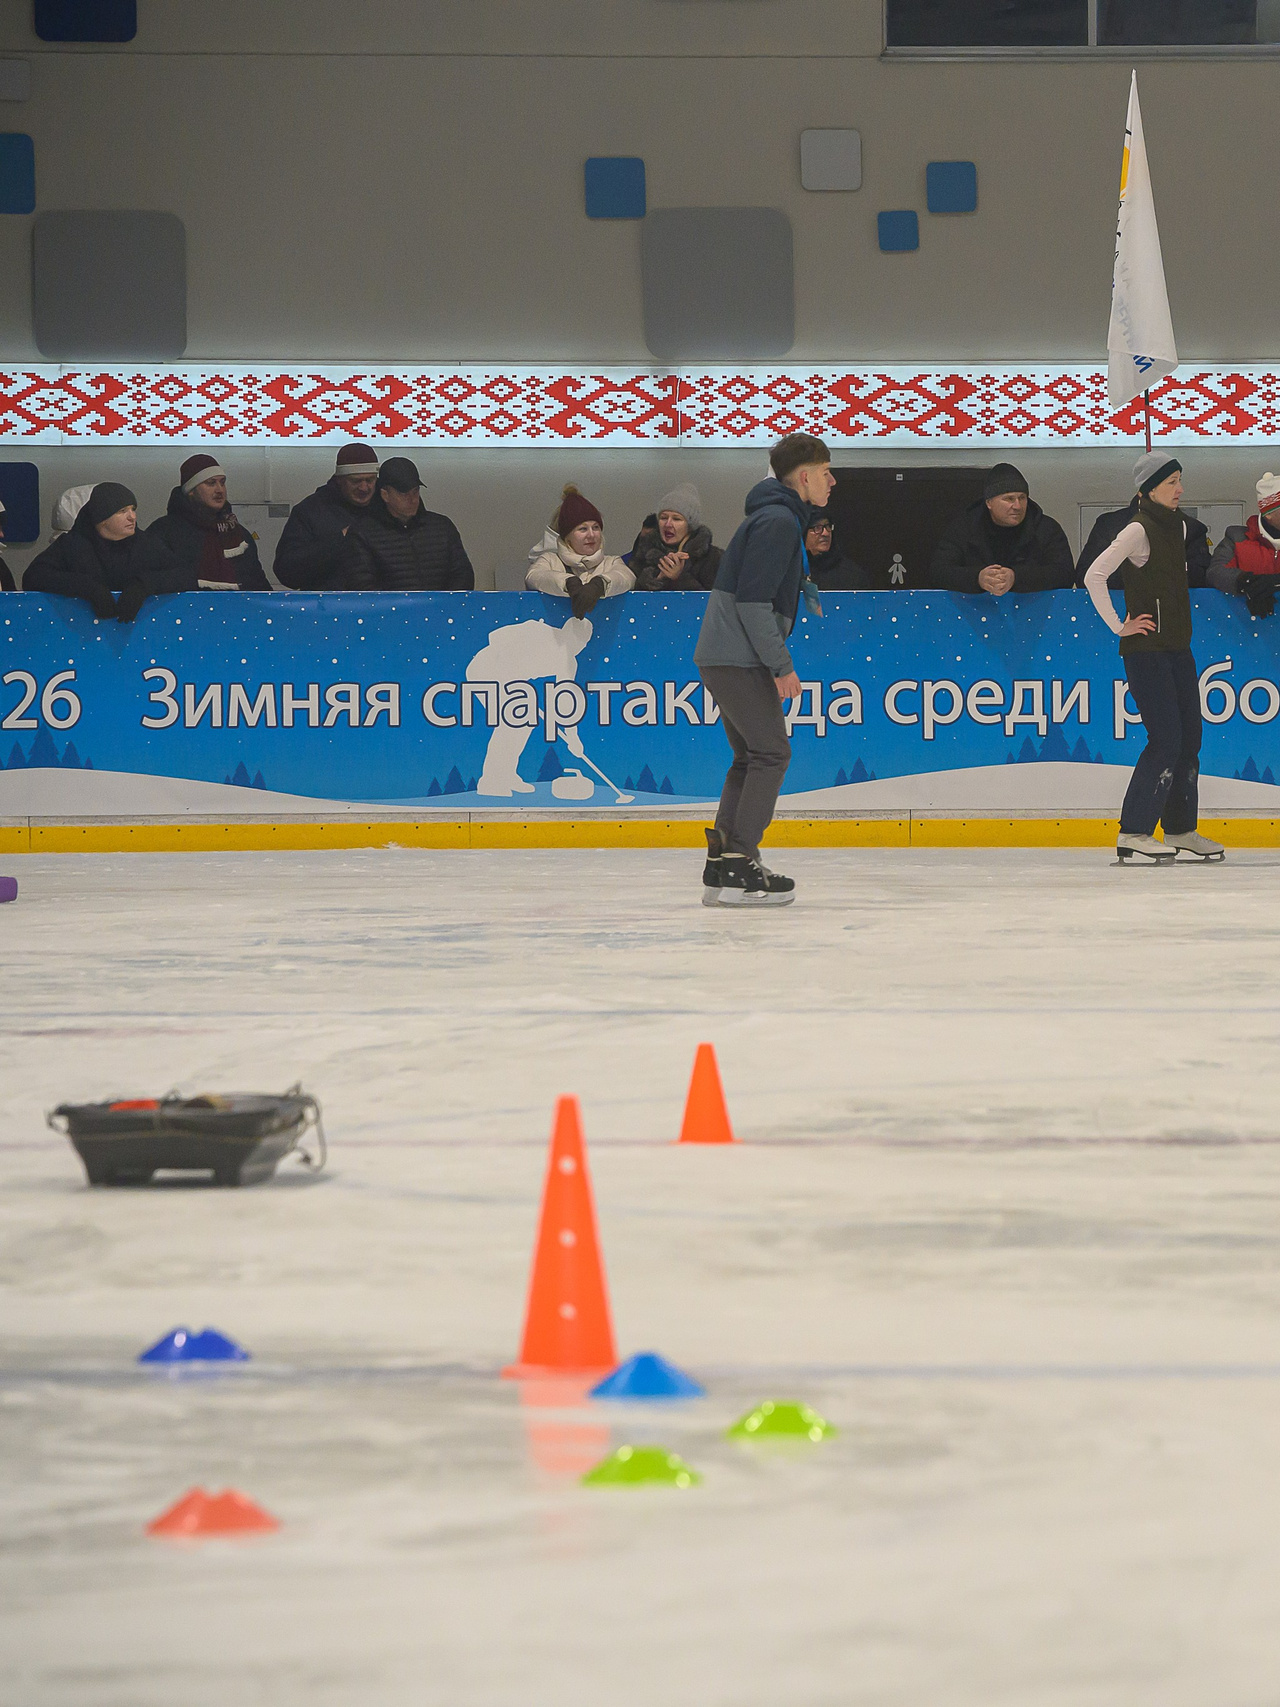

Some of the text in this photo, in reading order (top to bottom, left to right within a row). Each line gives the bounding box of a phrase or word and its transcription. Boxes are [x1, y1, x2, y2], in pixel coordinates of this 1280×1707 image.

[1, 669, 82, 729] 26
[140, 667, 401, 729] Зимняя
[421, 680, 864, 742] спартакда
[884, 679, 1090, 741] среди
